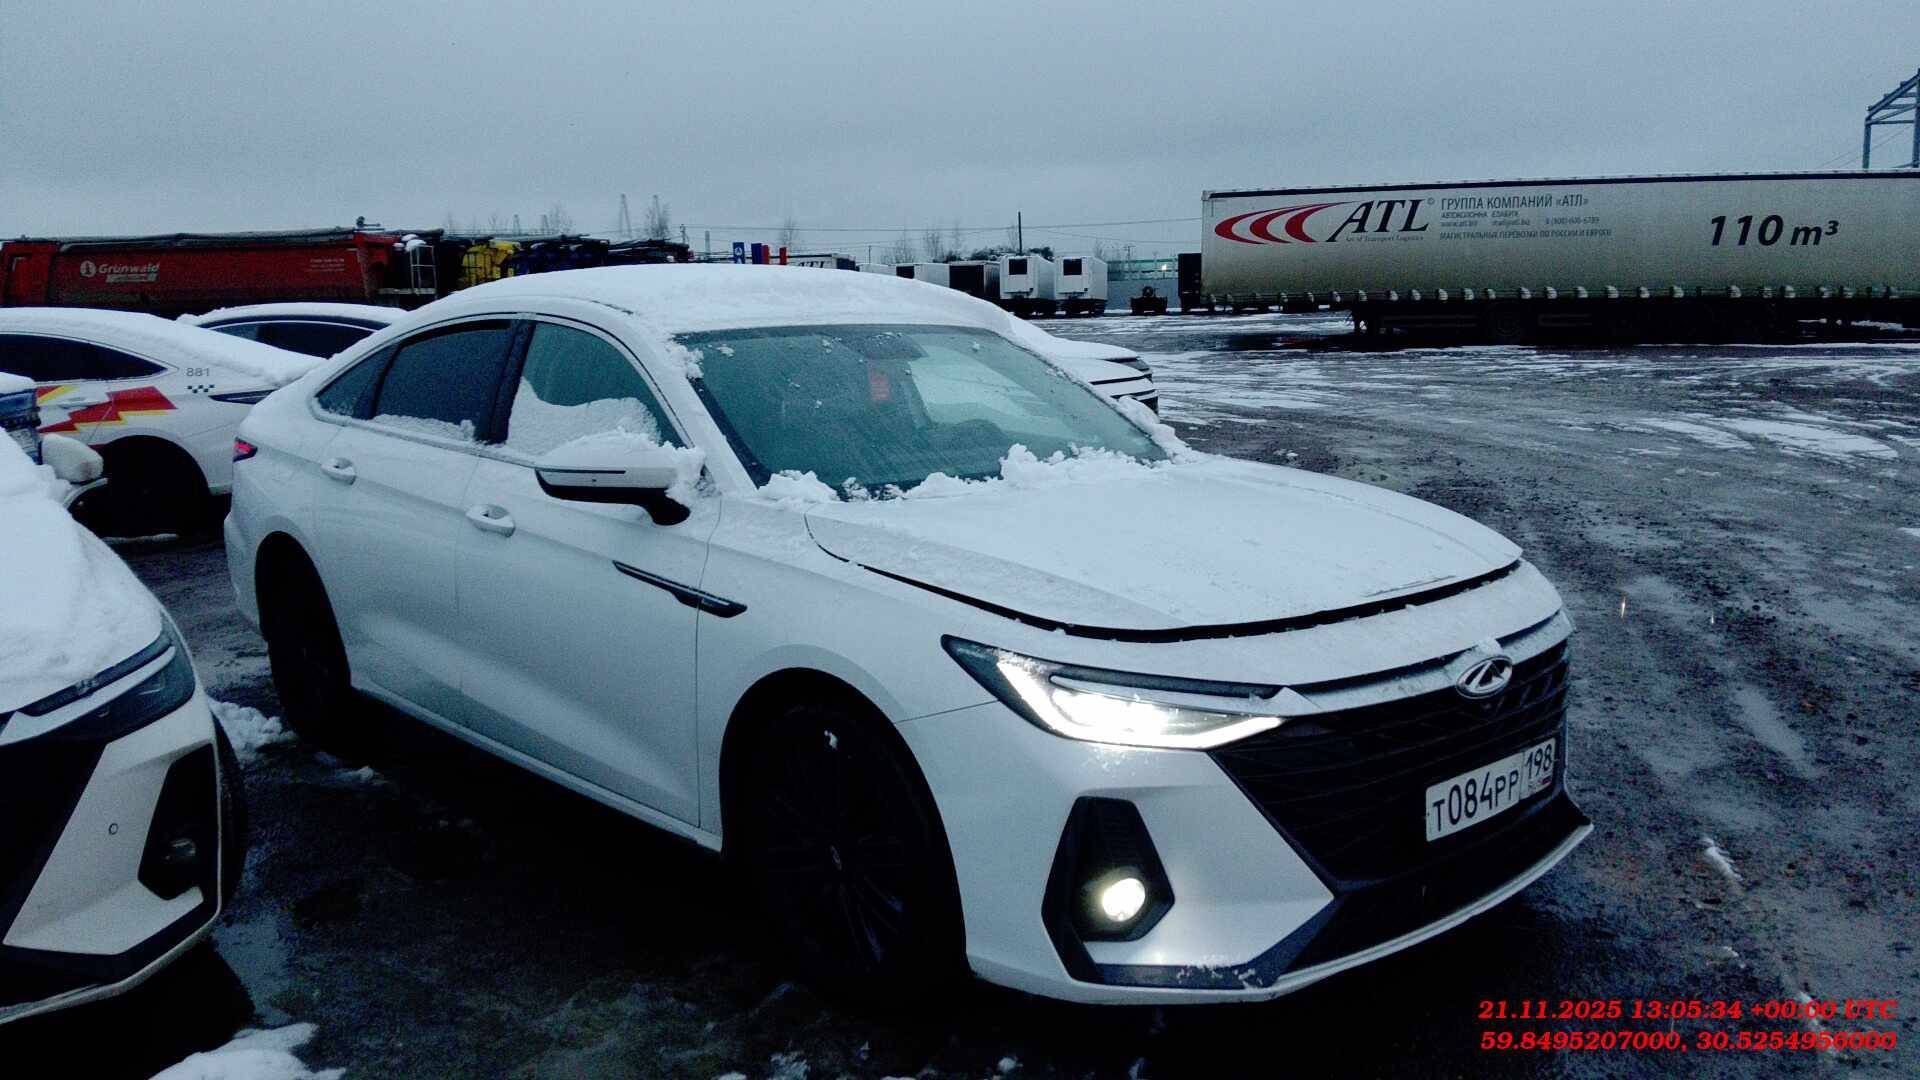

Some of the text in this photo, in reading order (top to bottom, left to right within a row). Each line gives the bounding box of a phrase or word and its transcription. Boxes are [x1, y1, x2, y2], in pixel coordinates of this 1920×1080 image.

[1441, 197, 1484, 211] ГРУППА
[1487, 195, 1553, 209] КОМПАНИЙ
[1325, 199, 1430, 242] ATL
[1711, 215, 1784, 246] 110
[186, 367, 210, 377] 881
[1524, 743, 1553, 780] 198
